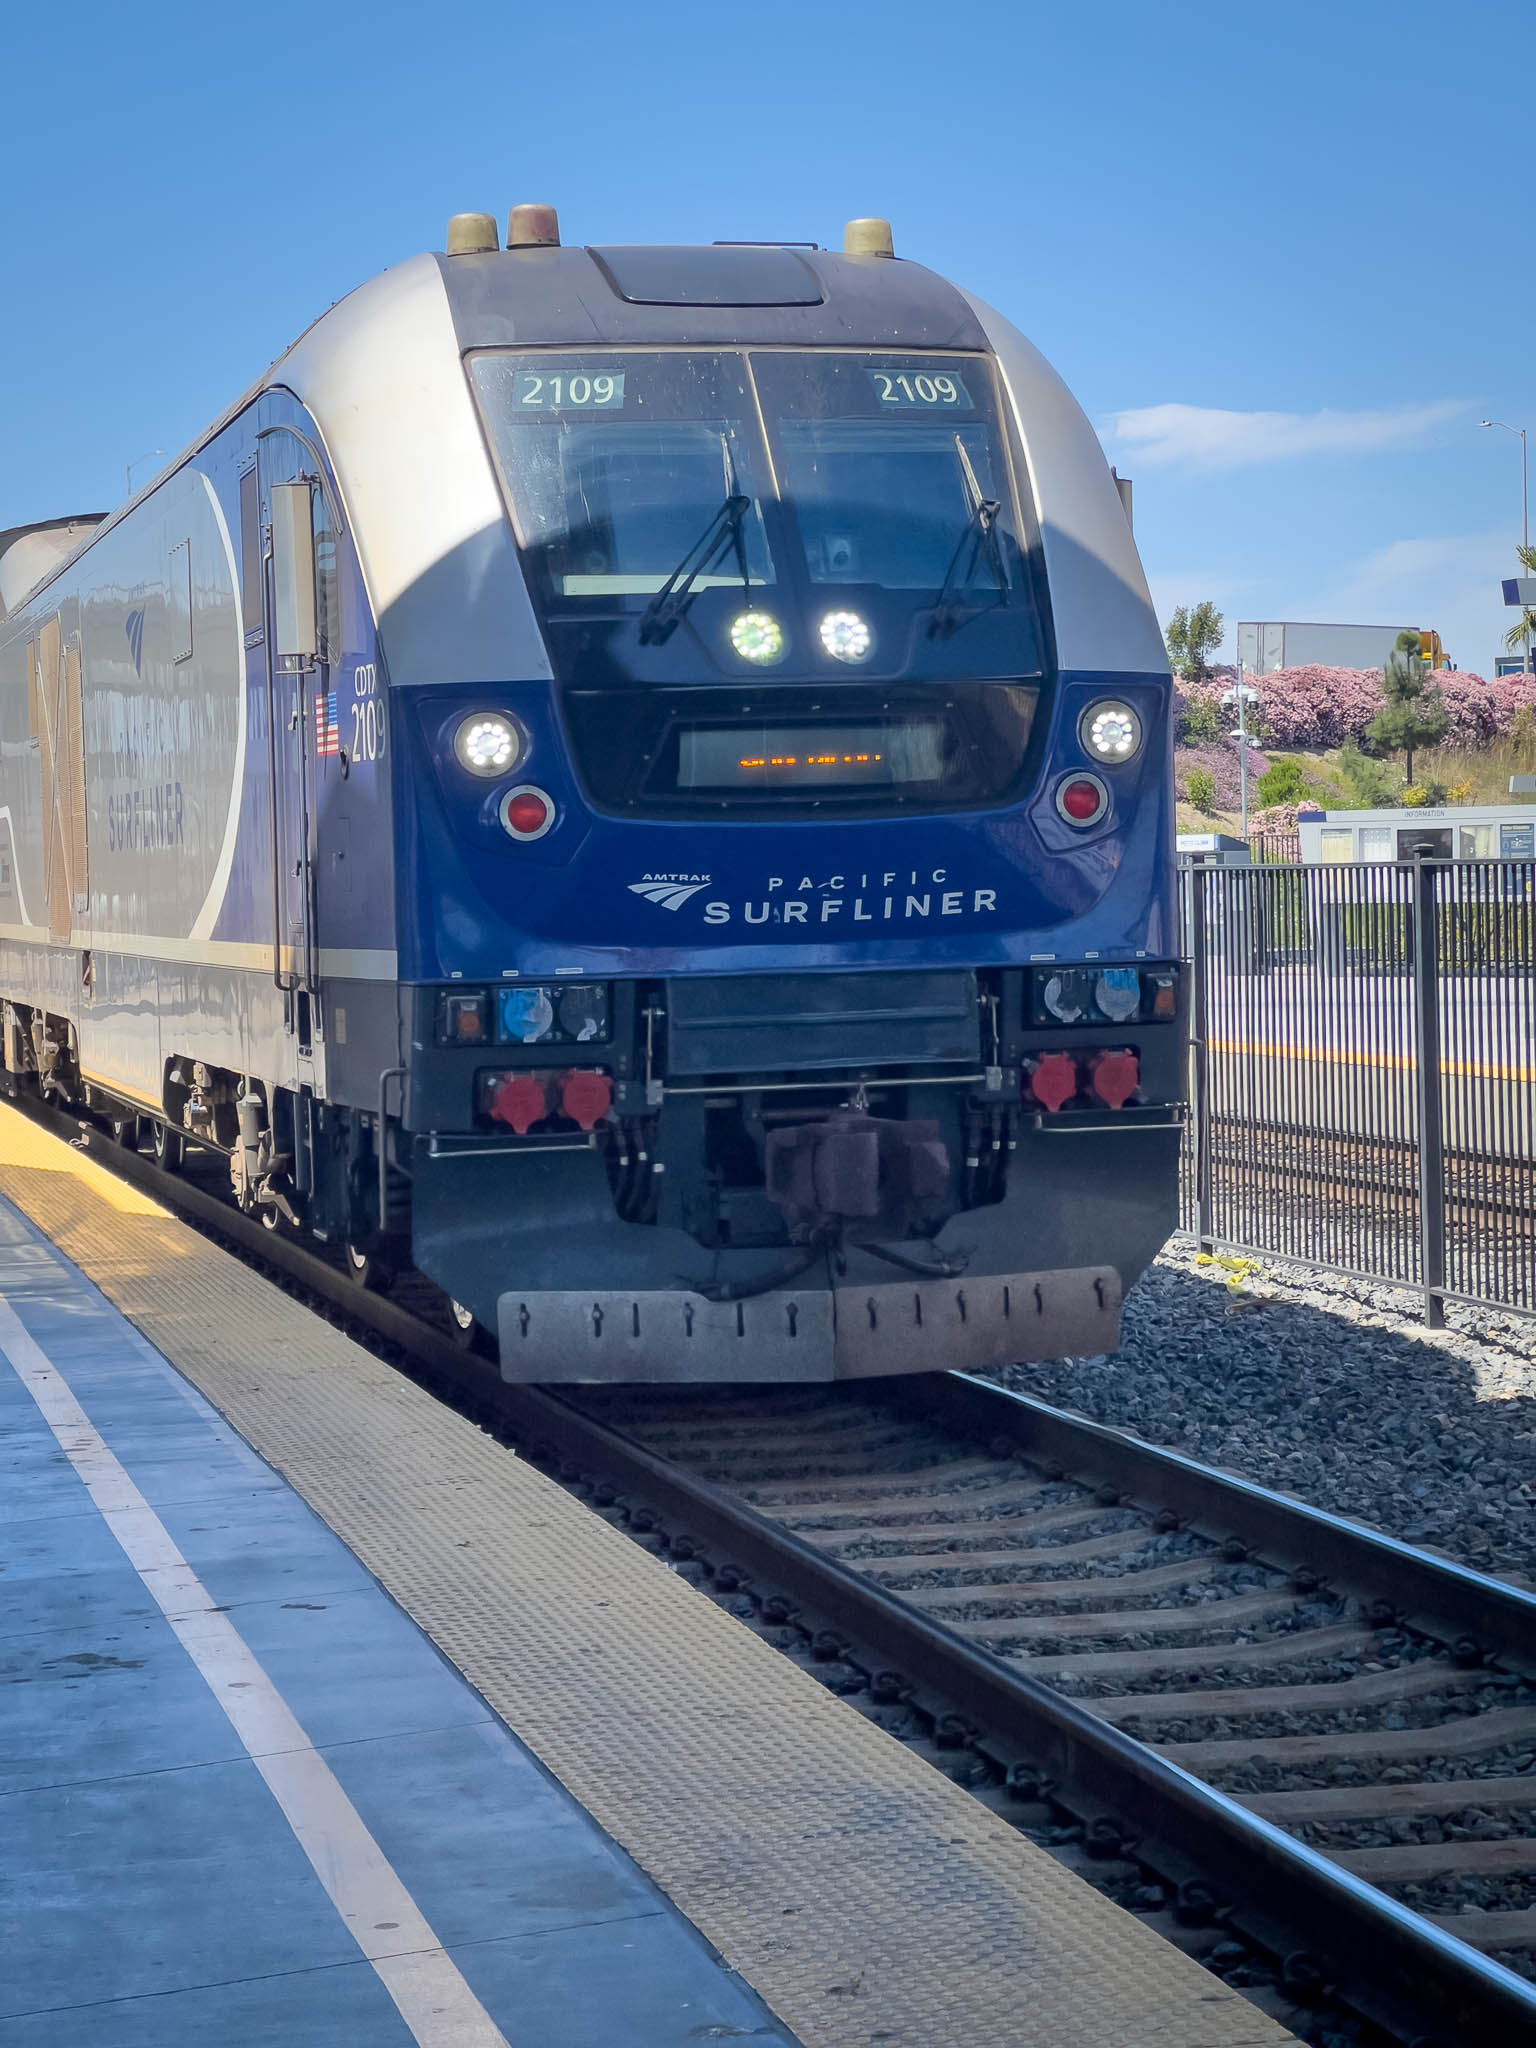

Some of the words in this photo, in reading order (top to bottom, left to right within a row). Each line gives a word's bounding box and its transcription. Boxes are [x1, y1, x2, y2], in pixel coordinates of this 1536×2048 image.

[522, 375, 614, 404] 2109
[874, 374, 957, 403] 2109
[351, 699, 385, 762] 2109
[108, 781, 184, 853] SURFLINER
[1404, 809, 1446, 818] INFORMATION
[642, 873, 711, 882] AMTRAK
[768, 868, 947, 892] PACIFIC
[703, 889, 997, 924] SURFLINER
